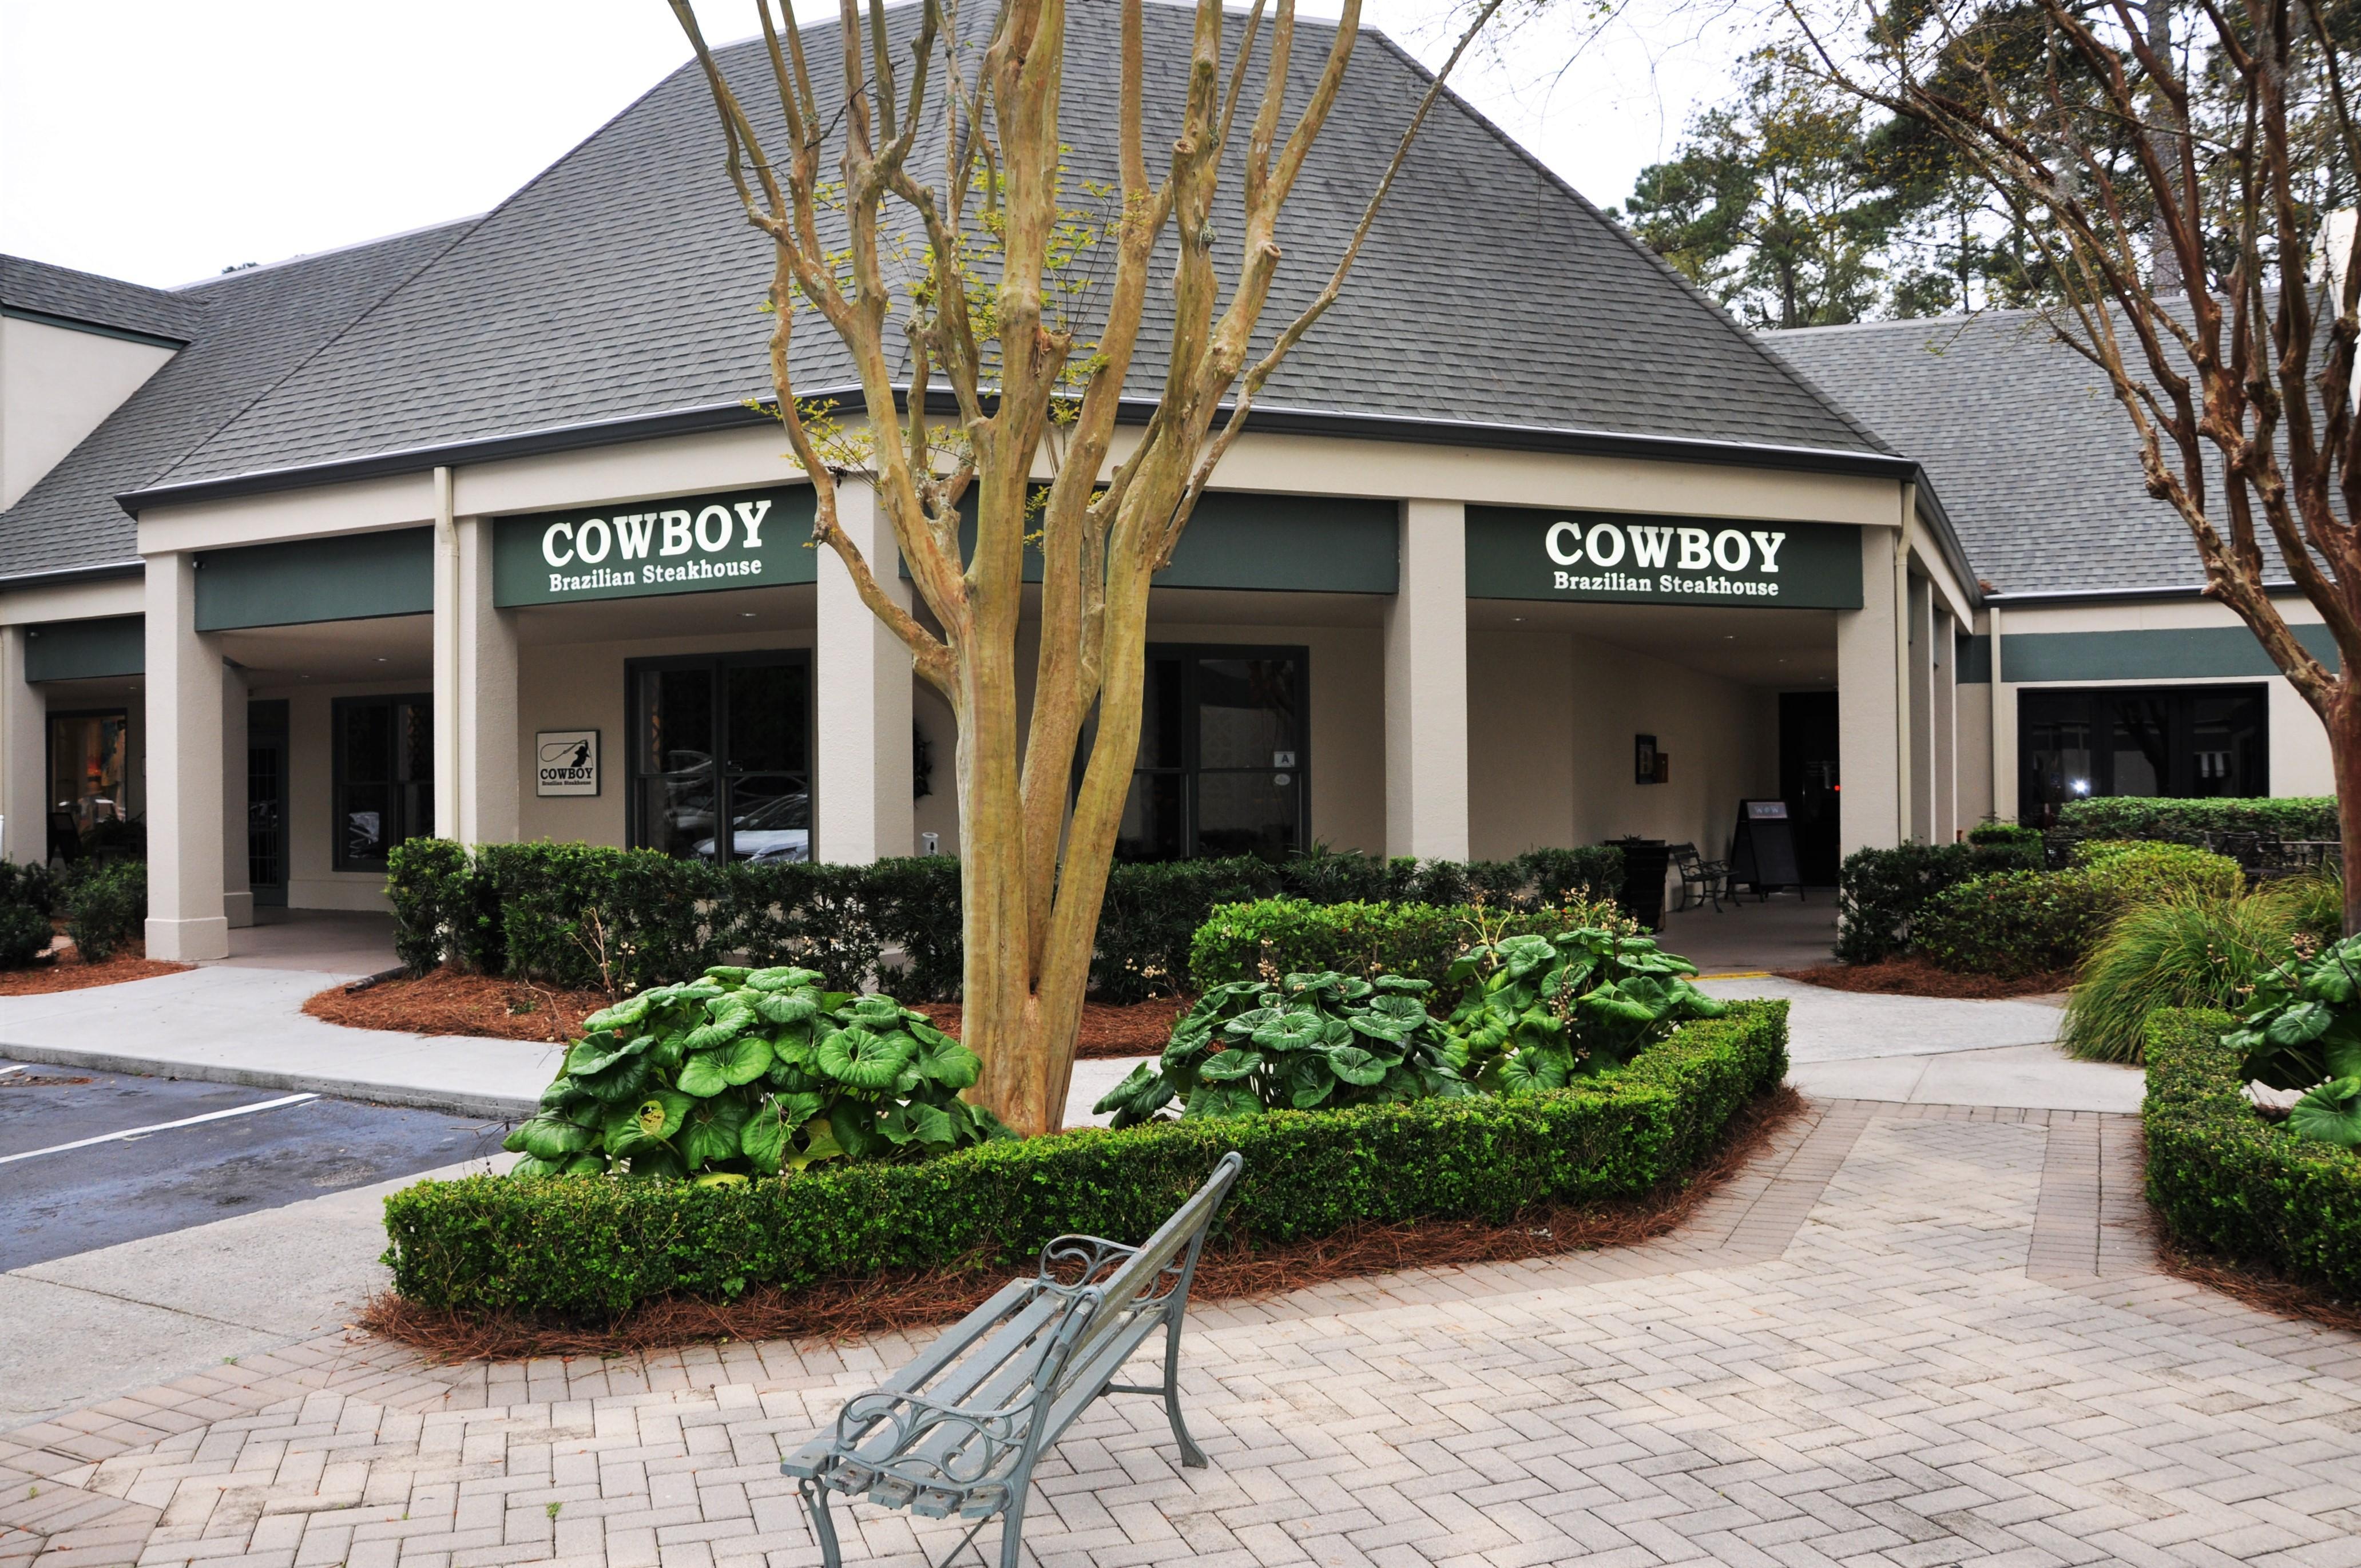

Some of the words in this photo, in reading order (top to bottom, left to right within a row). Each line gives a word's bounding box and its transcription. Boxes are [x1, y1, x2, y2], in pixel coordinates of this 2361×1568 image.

[542, 500, 772, 567] COWBOY
[1545, 522, 1785, 573] COWBOY
[549, 567, 636, 592] Brazilian
[642, 558, 762, 583] Steakhouse
[1553, 571, 1652, 592] Brazilian
[1660, 574, 1779, 596] Steakhouse
[1281, 754, 1289, 763] A
[540, 767, 593, 780] COWBOY
